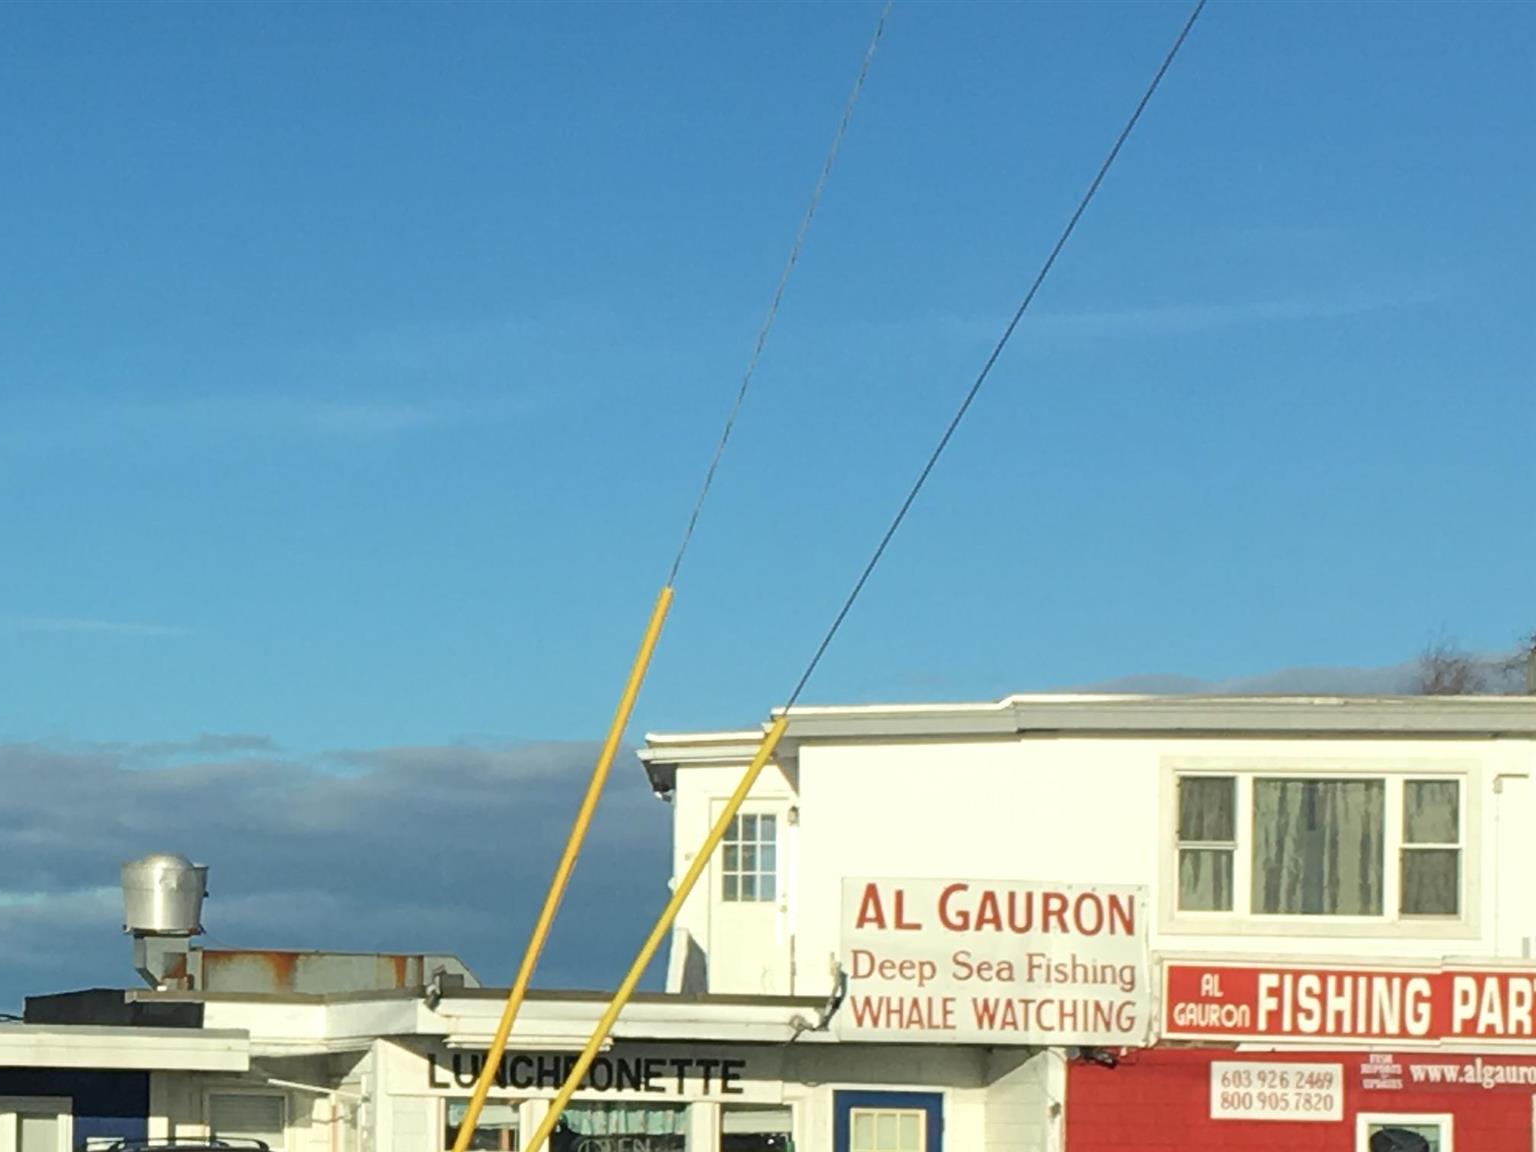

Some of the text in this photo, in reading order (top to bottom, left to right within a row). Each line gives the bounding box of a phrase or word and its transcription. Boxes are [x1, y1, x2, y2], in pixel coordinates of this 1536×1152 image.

[855, 882, 1136, 937] AL GAURON
[850, 949, 1136, 992] Deep Sea Fishing
[1201, 973, 1224, 997] AL
[850, 995, 1137, 1034] WHALE WATCHING
[1173, 1002, 1251, 1029] GAURON
[1257, 973, 1536, 1036] FISHING PAR
[1221, 1070, 1253, 1088] 603
[1257, 1070, 1290, 1089] 926
[1220, 1091, 1334, 1112] 800 905 7820
